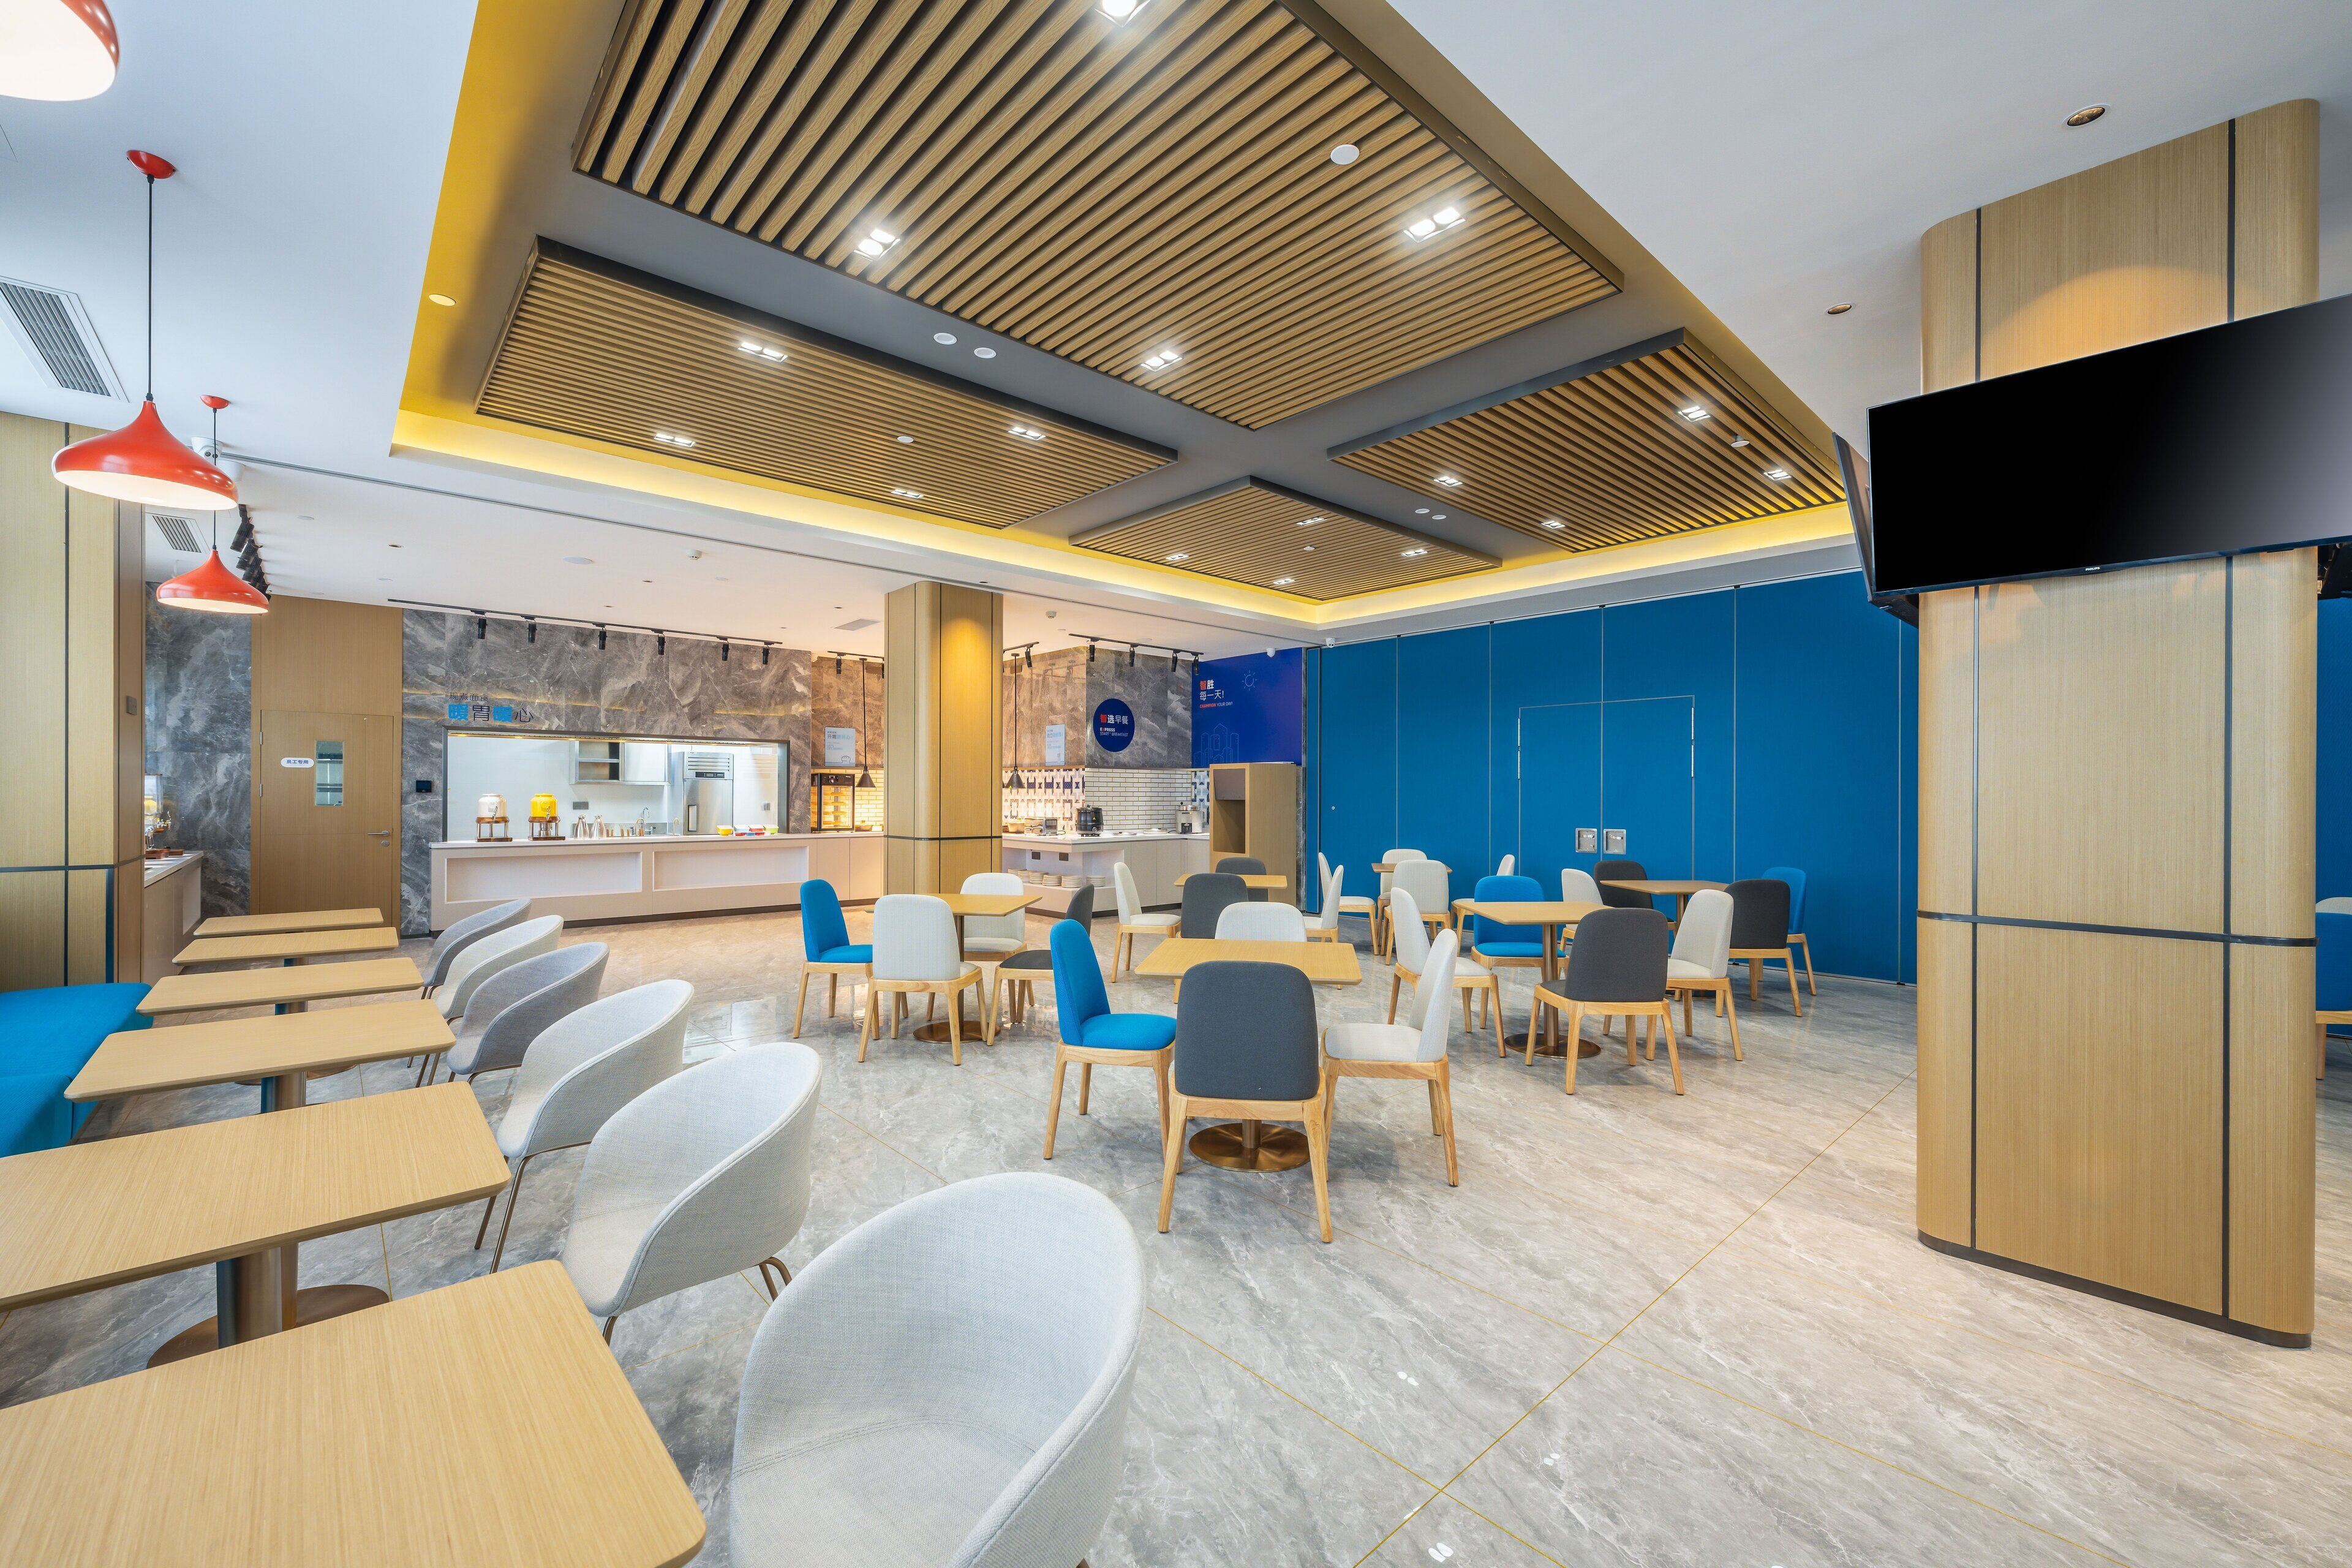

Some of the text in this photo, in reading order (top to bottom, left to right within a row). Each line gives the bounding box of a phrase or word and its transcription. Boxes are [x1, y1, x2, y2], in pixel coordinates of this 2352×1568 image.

[1200, 679, 1214, 690] 智胜
[450, 692, 489, 701] 现煮面食
[448, 704, 533, 722] 暖胃暖心
[1100, 714, 1128, 725] 智选早餐
